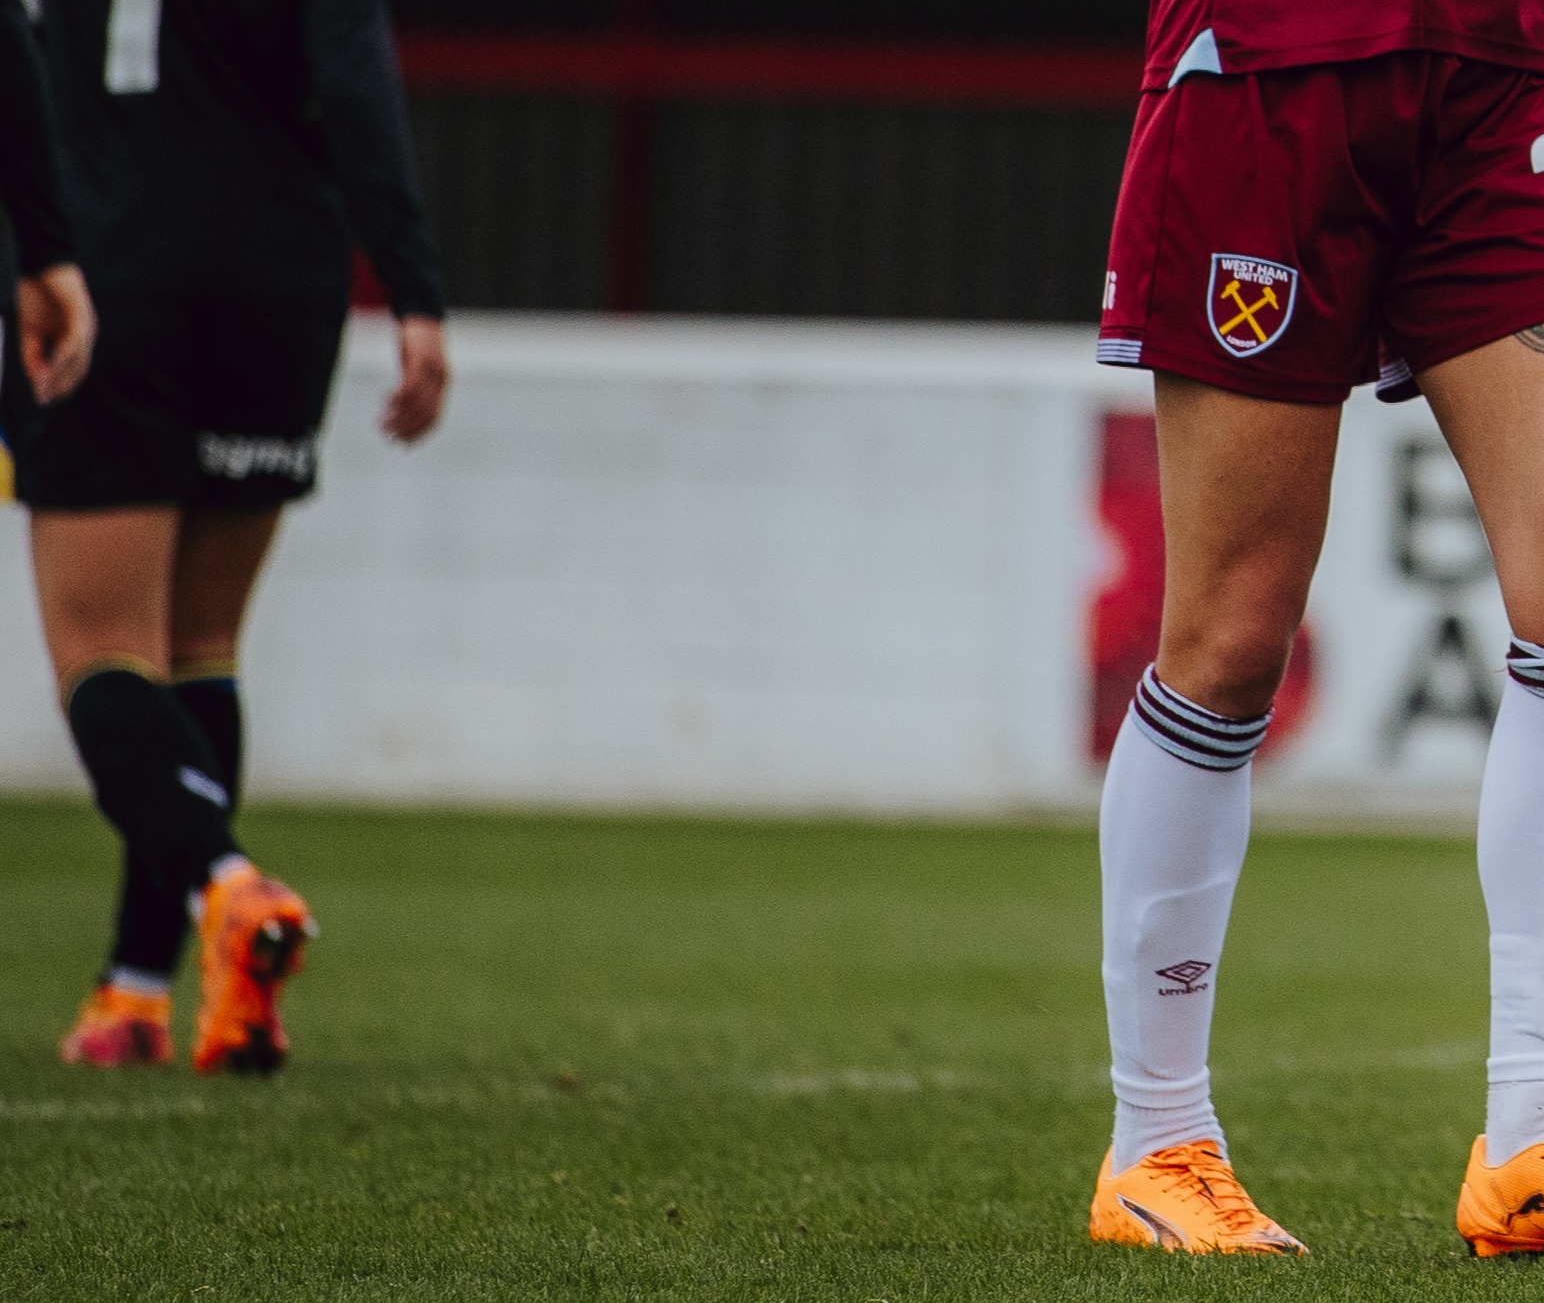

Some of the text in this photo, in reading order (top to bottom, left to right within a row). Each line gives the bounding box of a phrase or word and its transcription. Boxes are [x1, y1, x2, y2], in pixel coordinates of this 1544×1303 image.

[1222, 258, 1288, 282] WEST HAM
[1233, 270, 1273, 285] UNITED
